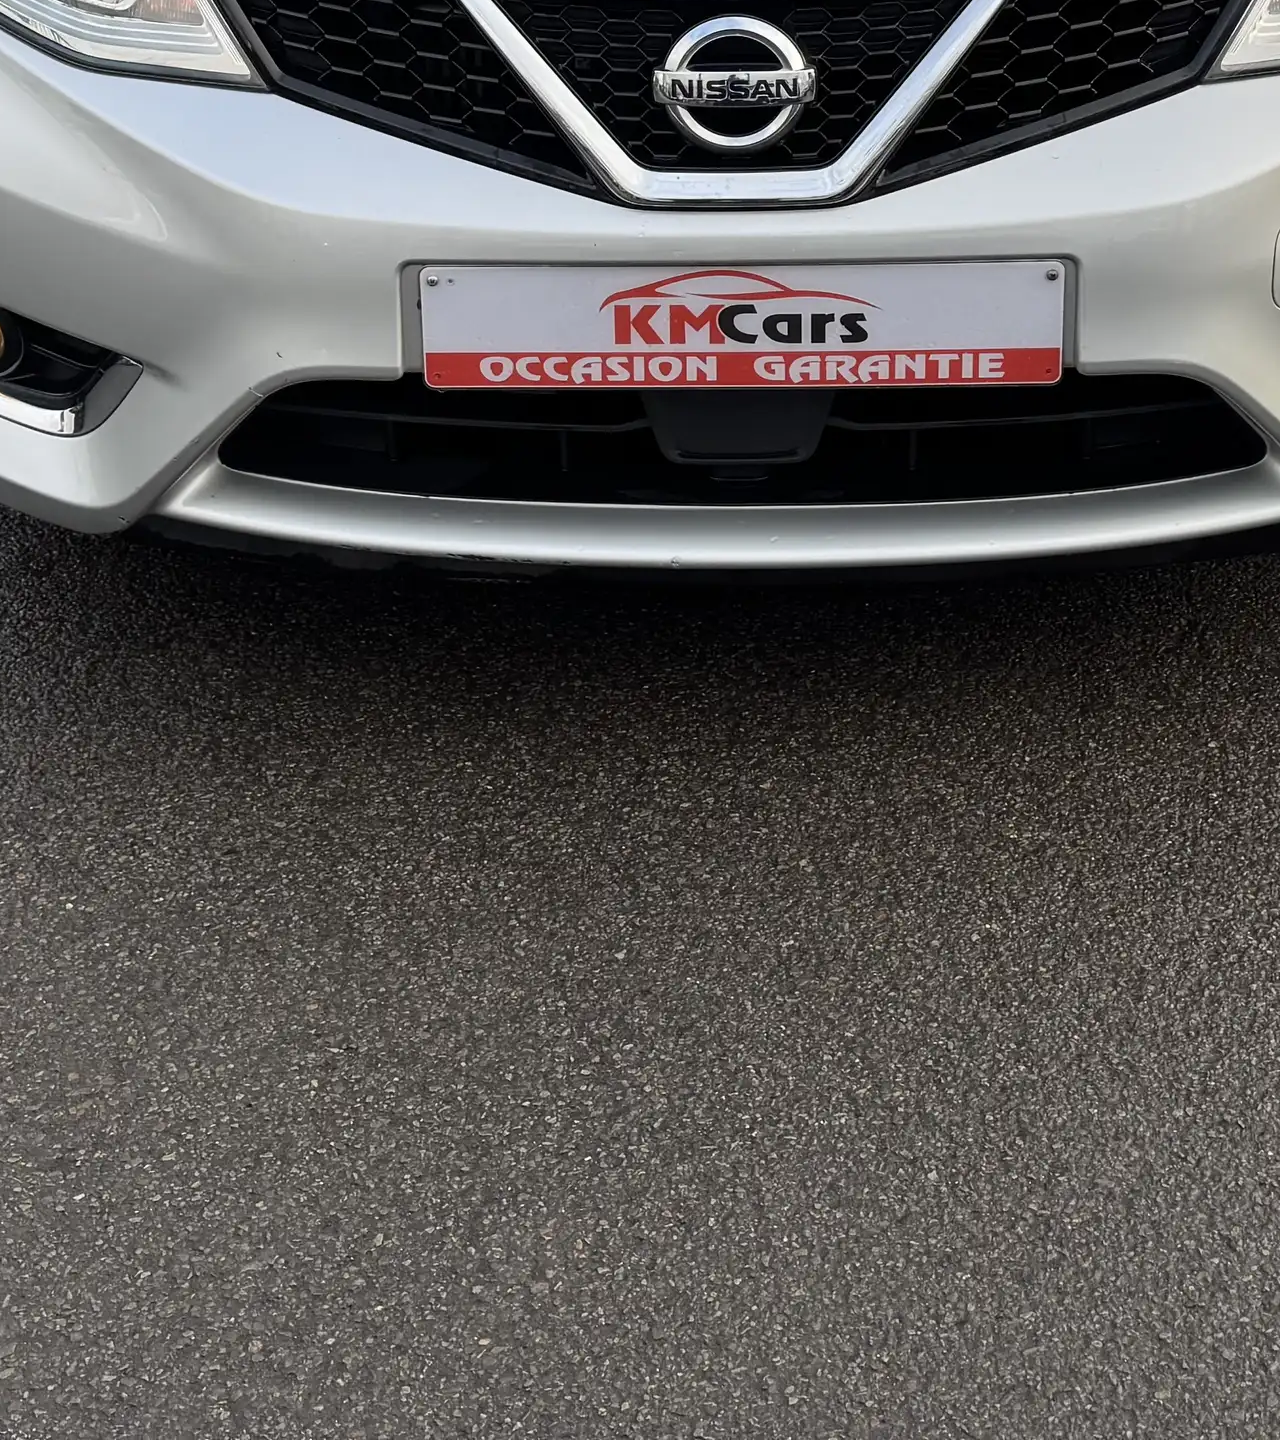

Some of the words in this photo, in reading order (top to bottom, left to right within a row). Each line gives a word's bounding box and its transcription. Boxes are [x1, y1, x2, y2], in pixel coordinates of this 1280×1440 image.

[671, 78, 799, 100] NISSAN
[613, 303, 870, 345] KMCars
[479, 355, 718, 384] OCCASION
[754, 351, 1006, 384] GARANTIE
